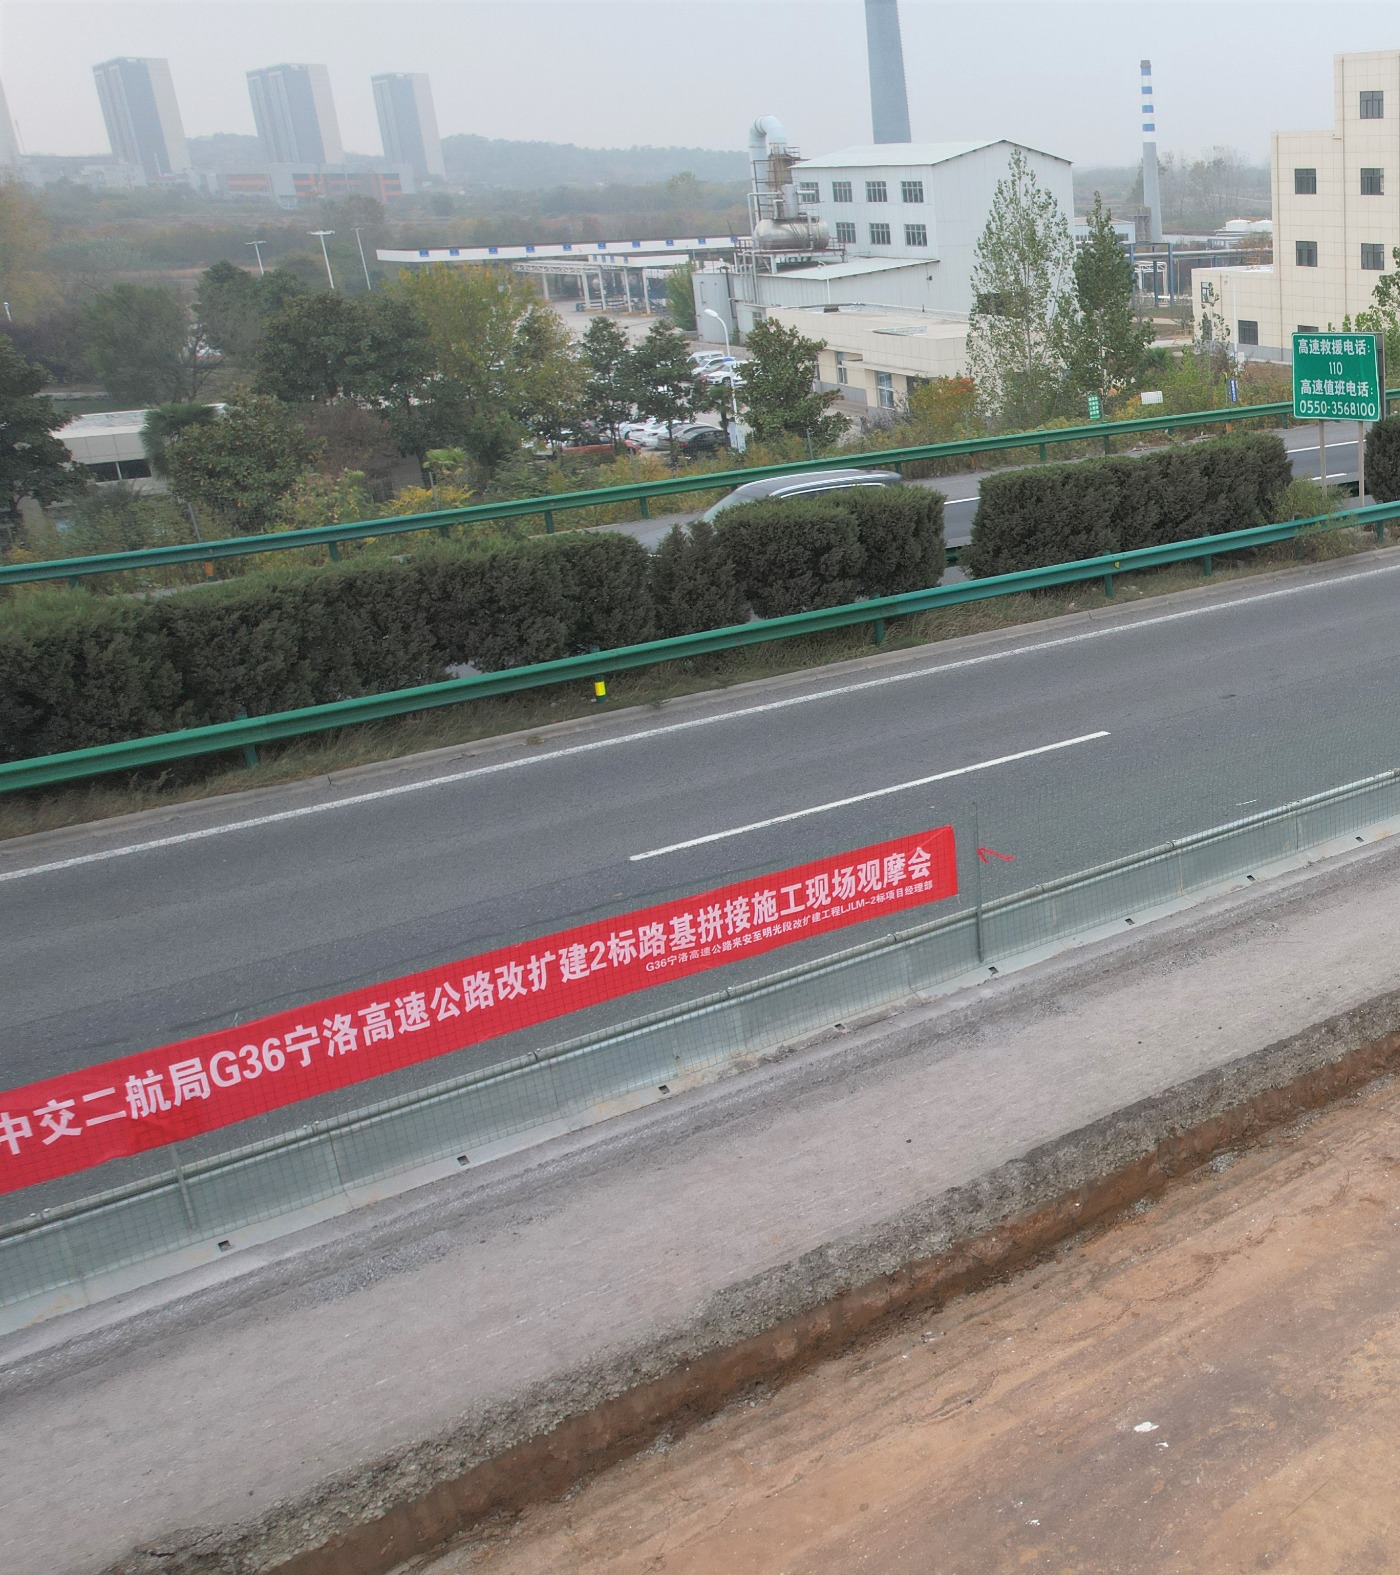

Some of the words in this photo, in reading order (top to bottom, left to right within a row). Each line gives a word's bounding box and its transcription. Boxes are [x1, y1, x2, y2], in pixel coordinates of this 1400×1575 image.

[1298, 338, 1370, 356] 高速救援电话：
[1329, 361, 1343, 375] 110
[1300, 379, 1373, 397] 高速值班电话：
[1300, 400, 1375, 416] 0550-3568100
[0, 847, 932, 1156] 中交二航局G36宁洛高速公路改扩建2标路基拼接施工现场观摩会
